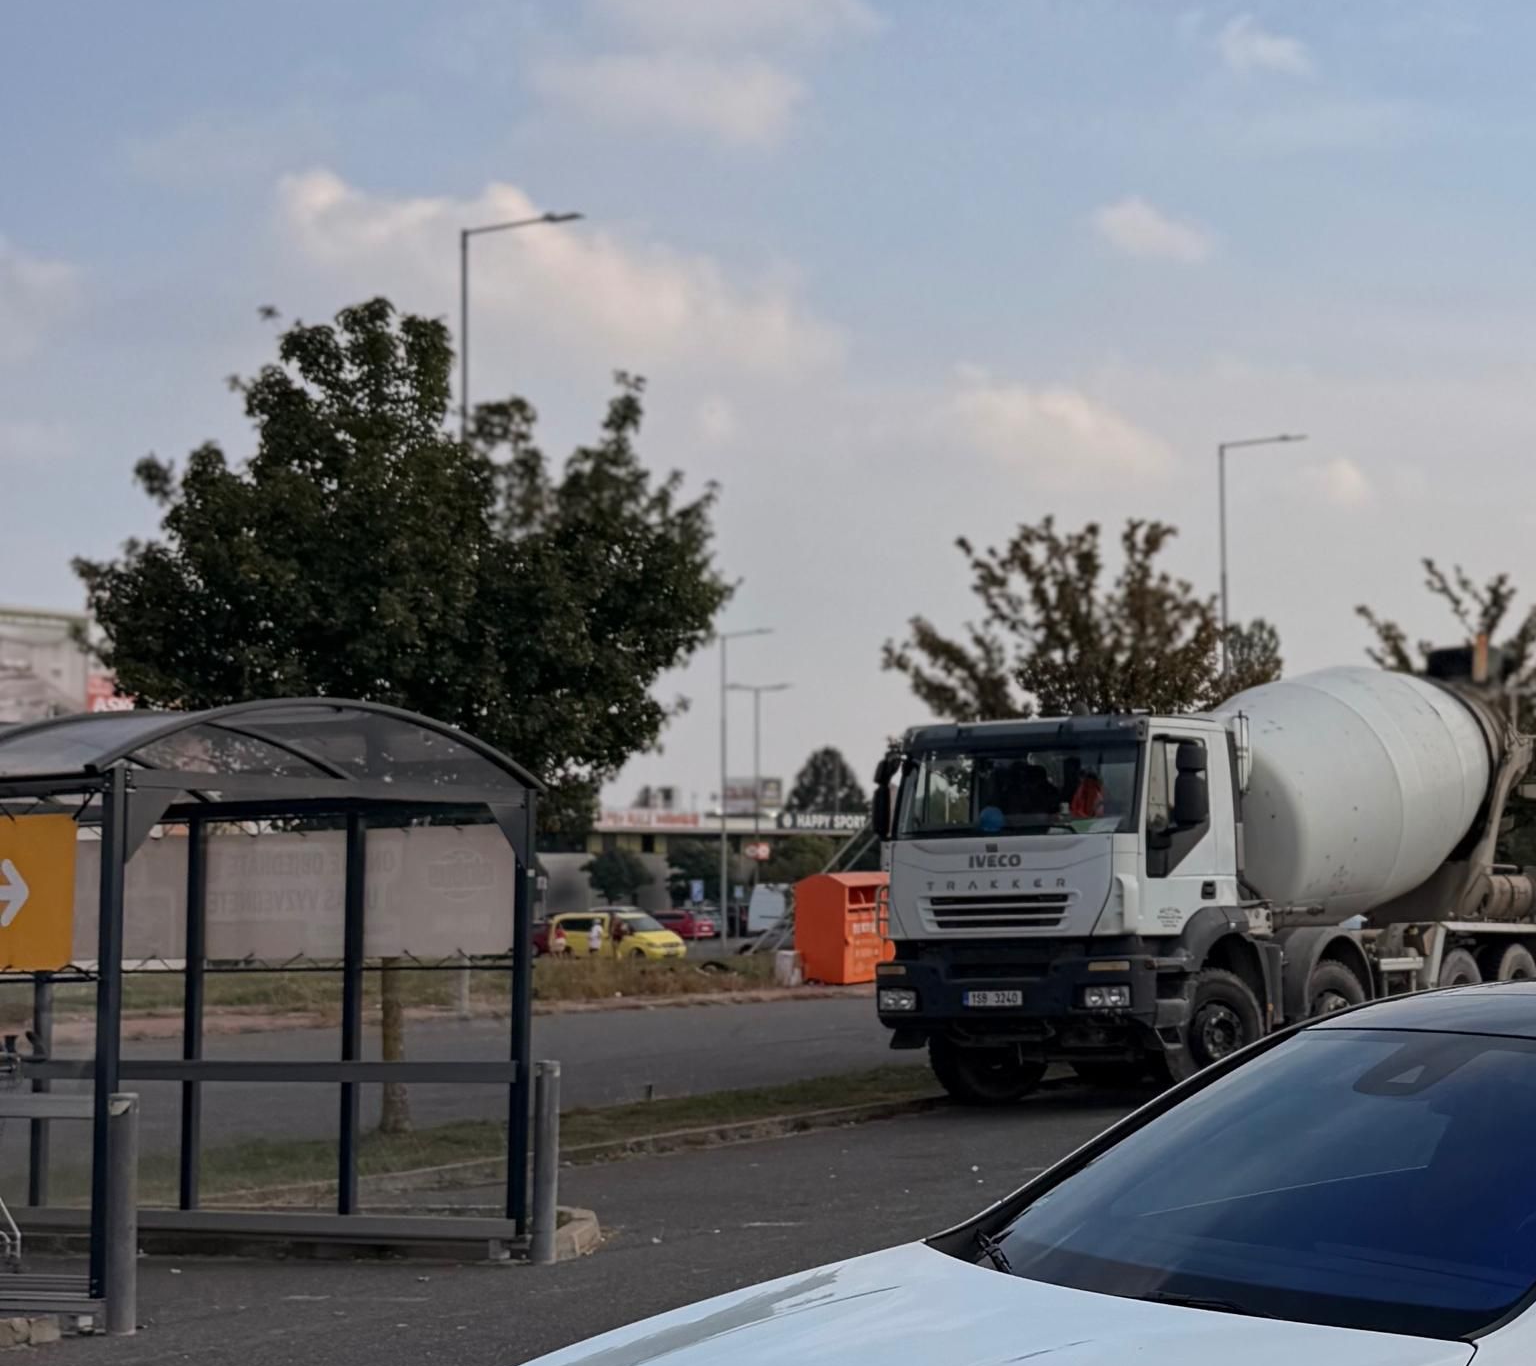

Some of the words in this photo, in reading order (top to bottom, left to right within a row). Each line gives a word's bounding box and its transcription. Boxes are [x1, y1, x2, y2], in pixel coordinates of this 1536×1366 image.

[797, 814, 831, 828] HAPPY
[833, 815, 866, 828] SPORT
[968, 853, 1022, 868] IVECO
[926, 878, 1066, 891] TRAKKER
